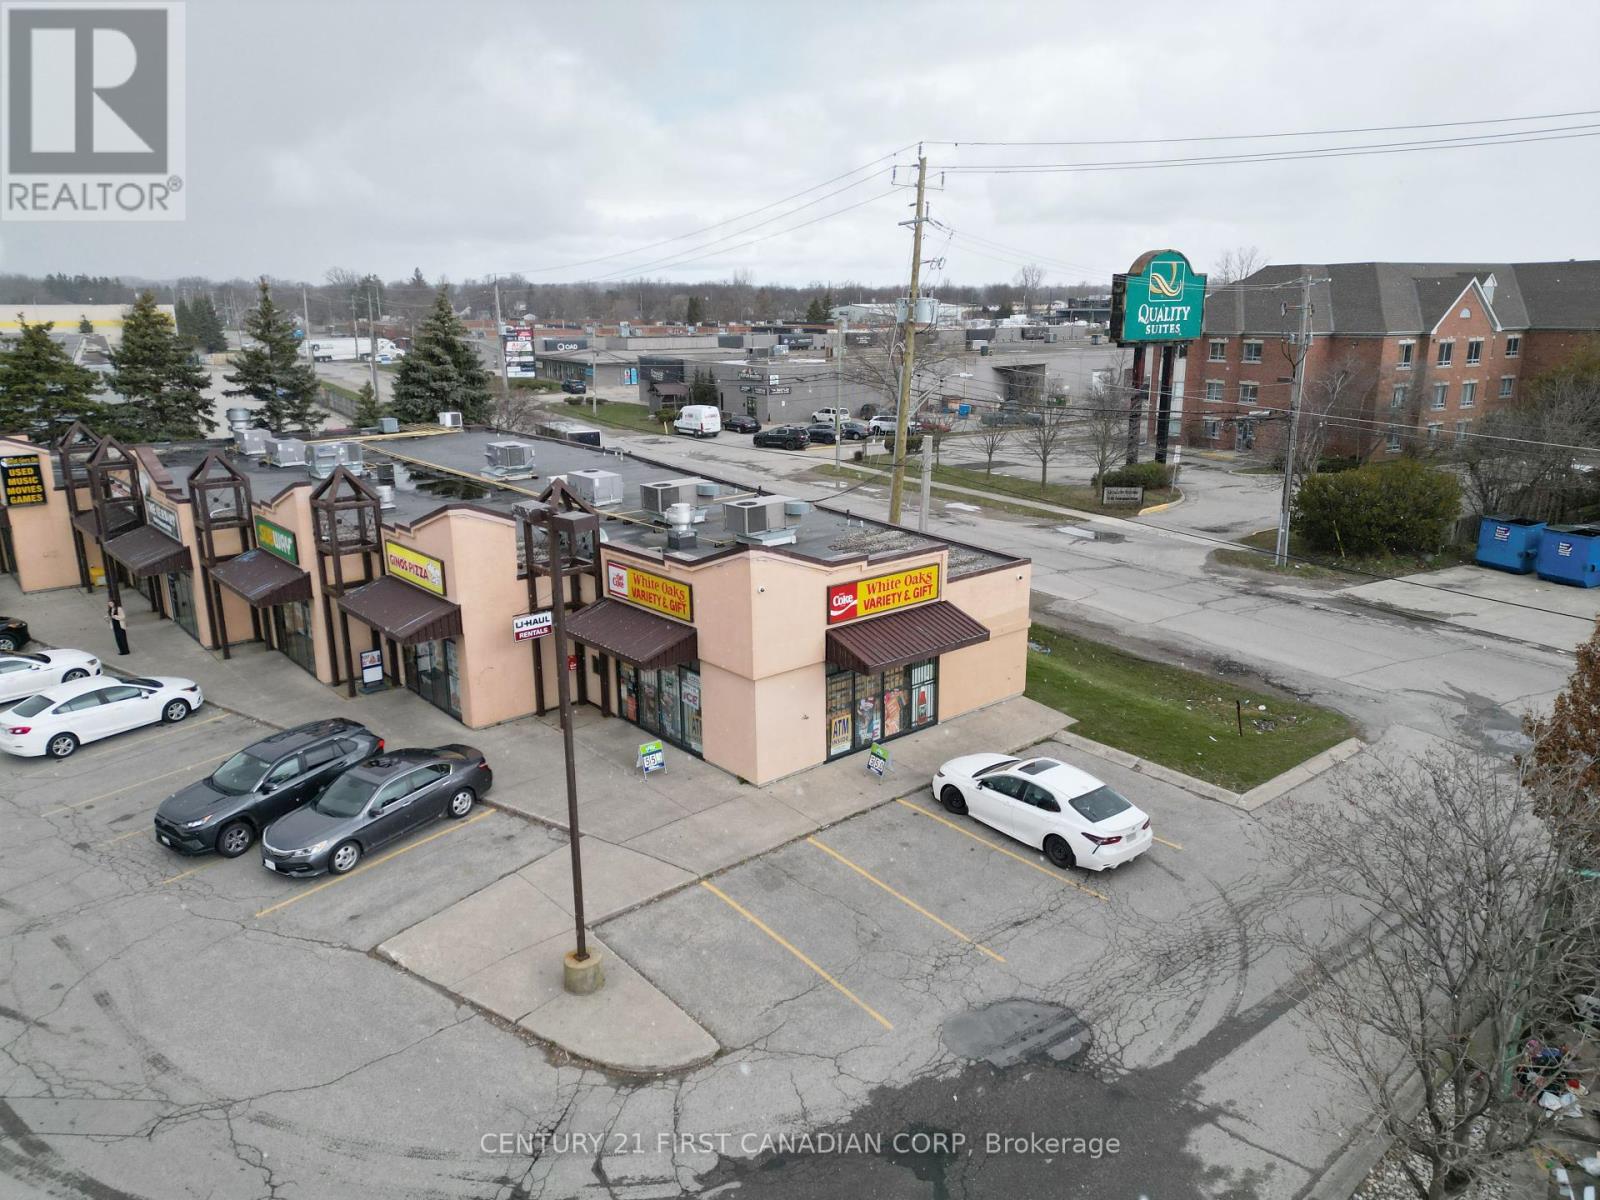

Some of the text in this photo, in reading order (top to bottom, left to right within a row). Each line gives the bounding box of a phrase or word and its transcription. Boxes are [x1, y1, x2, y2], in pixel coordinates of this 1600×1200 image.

[1138, 304, 1191, 324] QUALITY
[1145, 323, 1181, 335] SUITES
[9, 467, 34, 477] USED
[8, 476, 39, 486] MUSIC
[7, 484, 43, 495] MOVIES
[10, 493, 44, 505] GAMES
[408, 562, 429, 580] PIZZA
[632, 572, 686, 601] White Oaks
[866, 571, 933, 595] White Oaks
[631, 587, 687, 615] VARIETY & GIFT
[832, 593, 854, 607] Coke
[863, 584, 934, 611] VARIETY & GIFT
[515, 615, 551, 629] U-HAUL
[519, 627, 549, 639] RENTALS
[682, 692, 698, 705] ICE
[833, 717, 850, 739] ATM
